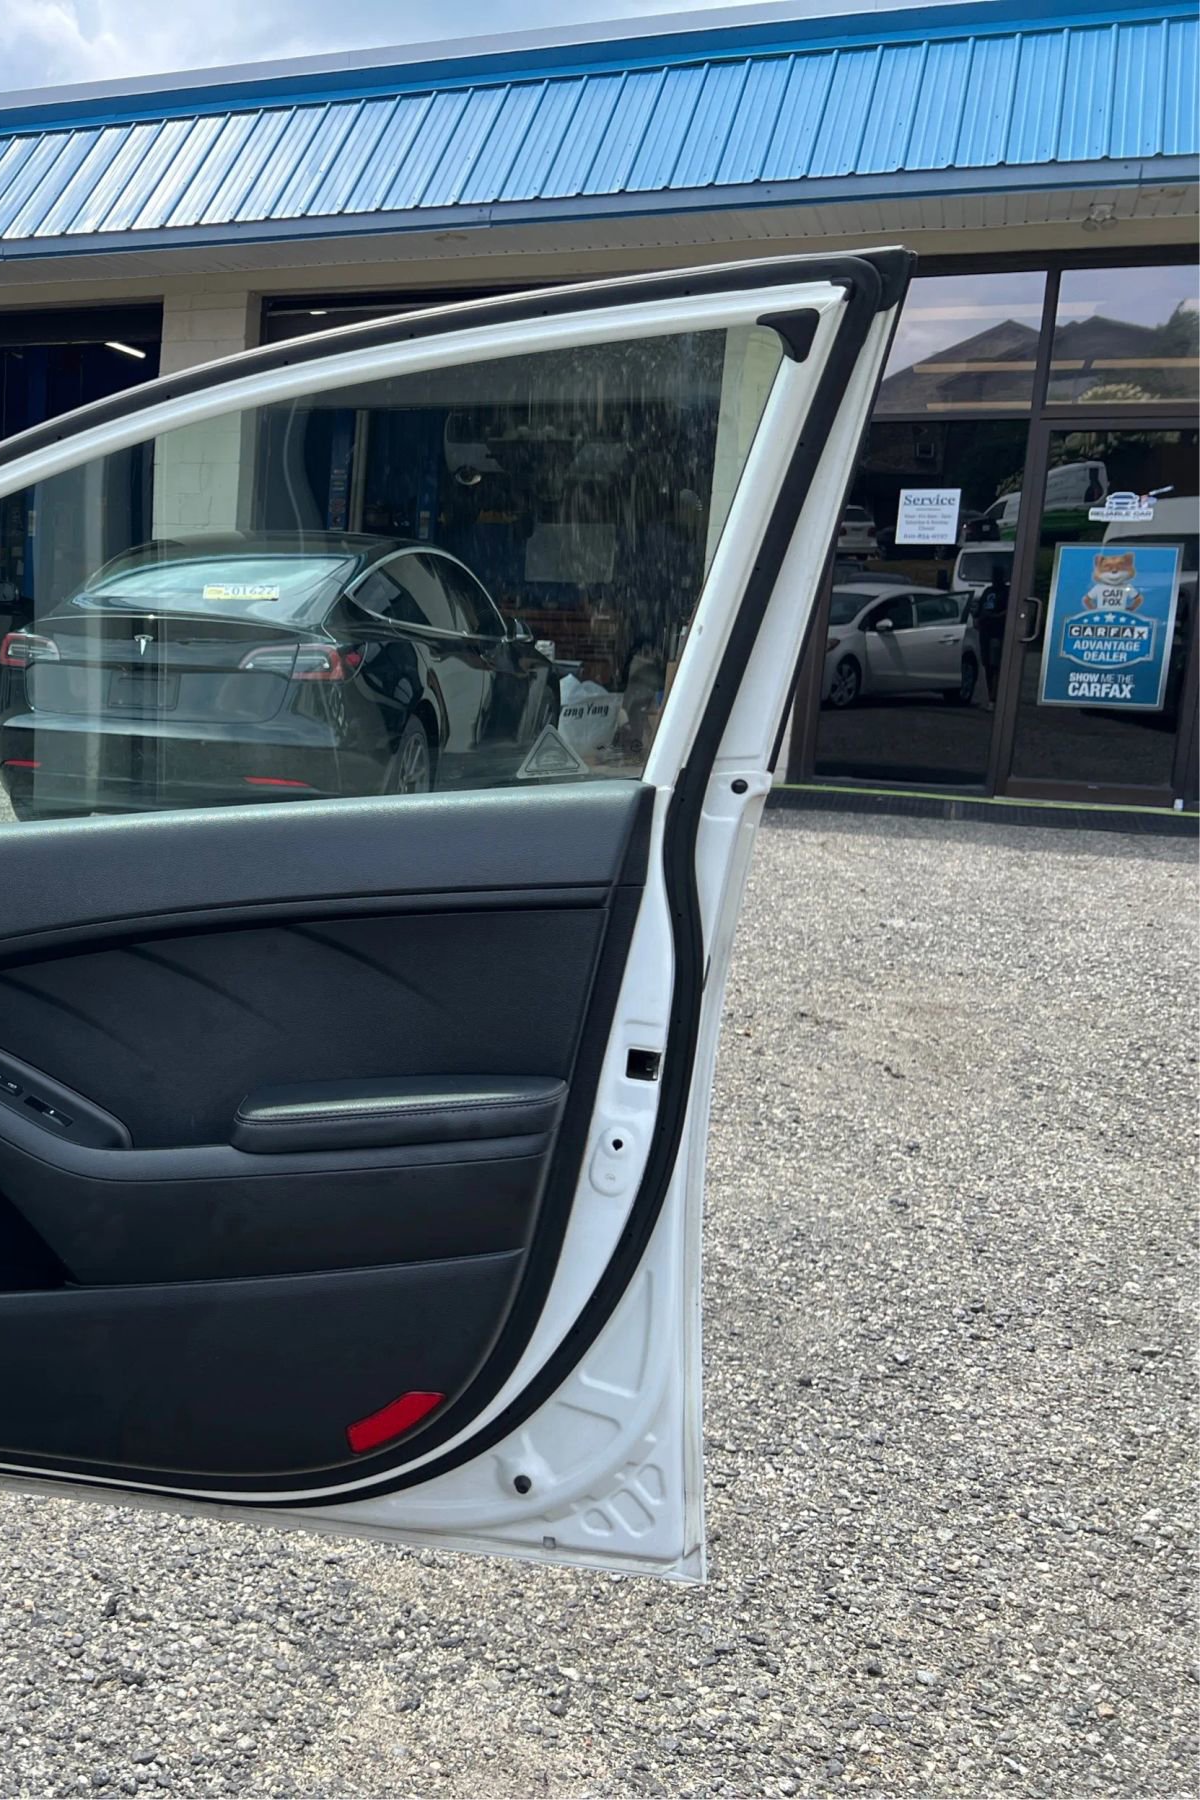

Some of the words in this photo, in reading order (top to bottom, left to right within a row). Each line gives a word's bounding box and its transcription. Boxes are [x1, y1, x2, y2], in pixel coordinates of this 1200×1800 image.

[904, 494, 955, 506] Service
[1102, 589, 1123, 597] CAR
[1102, 598, 1122, 606] FOX
[1070, 626, 1147, 639] CARFAX
[1073, 640, 1141, 651] ADVANTAGE
[1083, 651, 1127, 662] DEALER
[1069, 672, 1099, 682] SHOW
[1100, 674, 1115, 683] ME
[1117, 674, 1134, 684] THE
[1068, 682, 1133, 698] CARFAX
